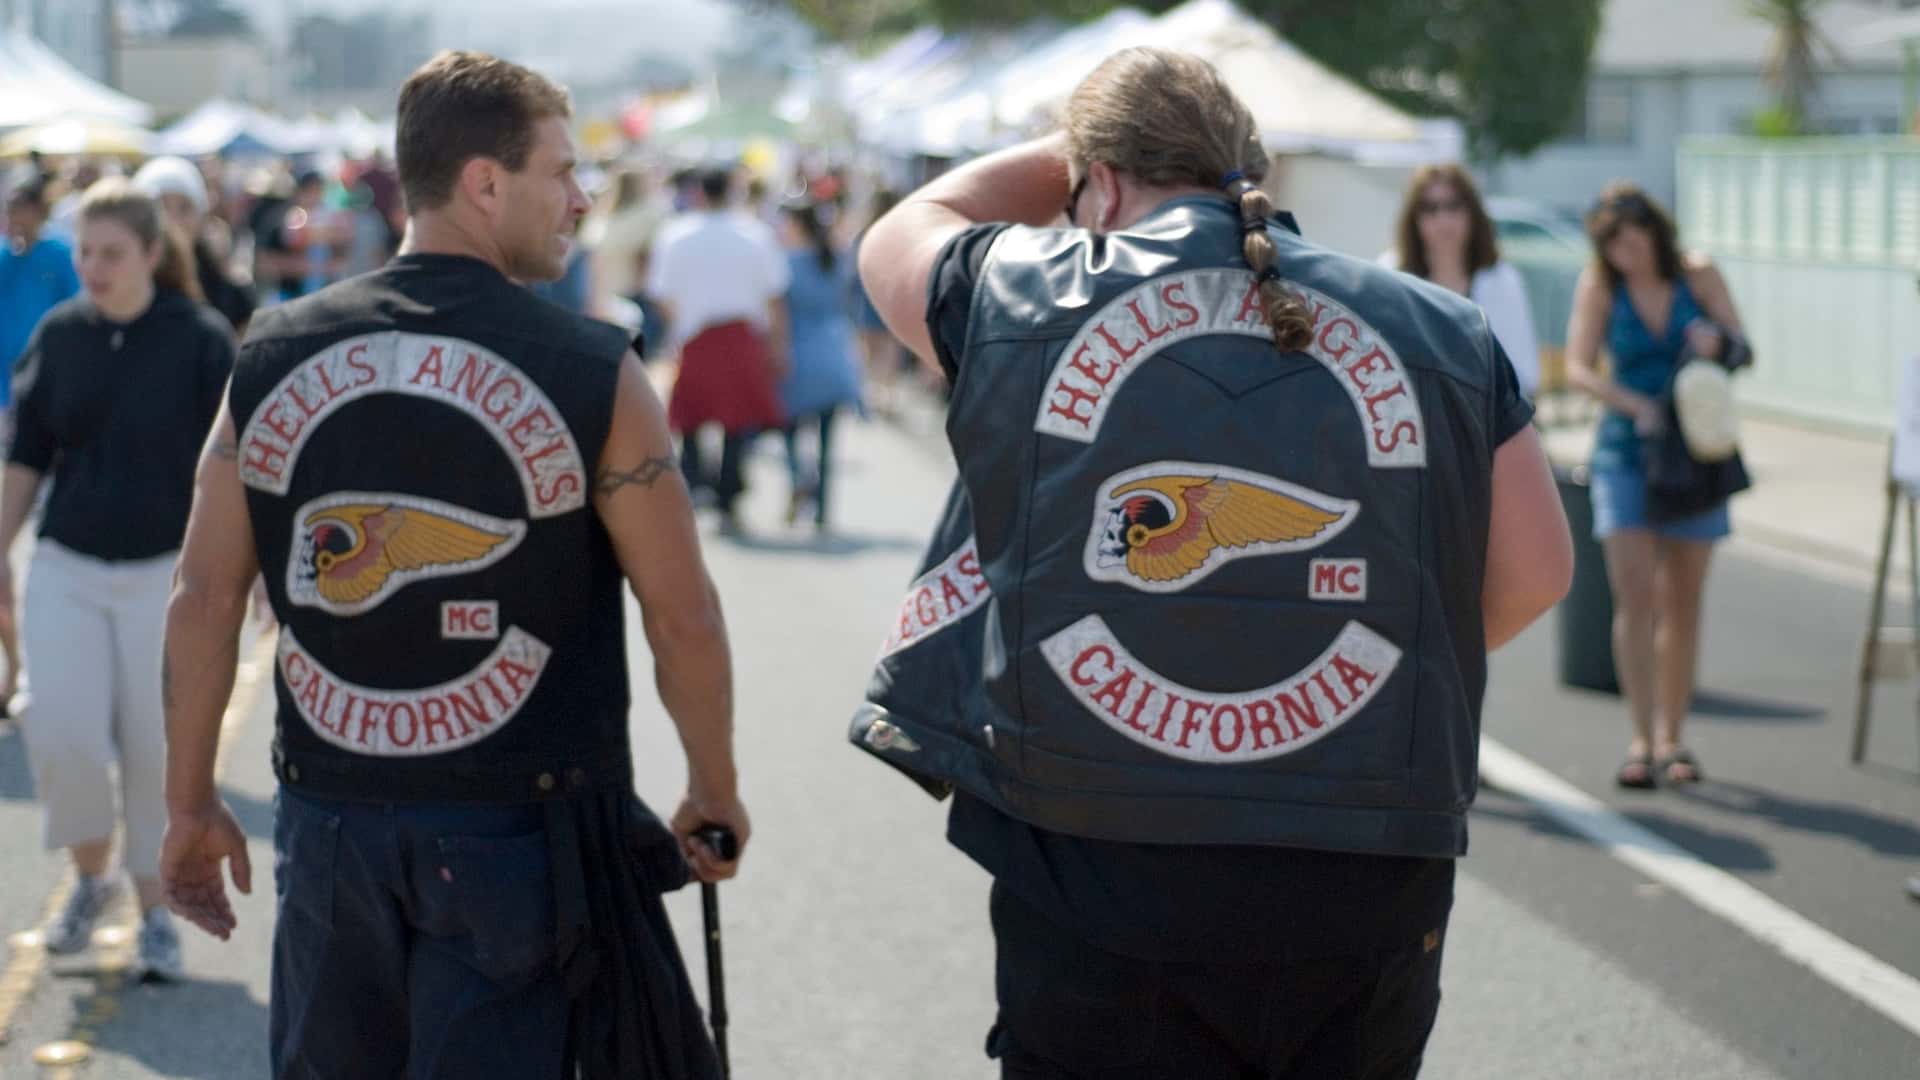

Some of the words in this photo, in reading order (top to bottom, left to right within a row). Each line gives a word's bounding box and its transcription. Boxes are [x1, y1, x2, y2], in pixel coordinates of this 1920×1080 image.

[1048, 281, 1200, 430] HELLS
[245, 343, 377, 481] HELLS
[411, 345, 579, 510] ANGELS
[447, 607, 492, 632] MC
[884, 549, 990, 648] EGAS
[1314, 564, 1361, 594] MC
[283, 651, 537, 748] CALIFORNIA
[1069, 644, 1378, 753] CALIFORNIA
